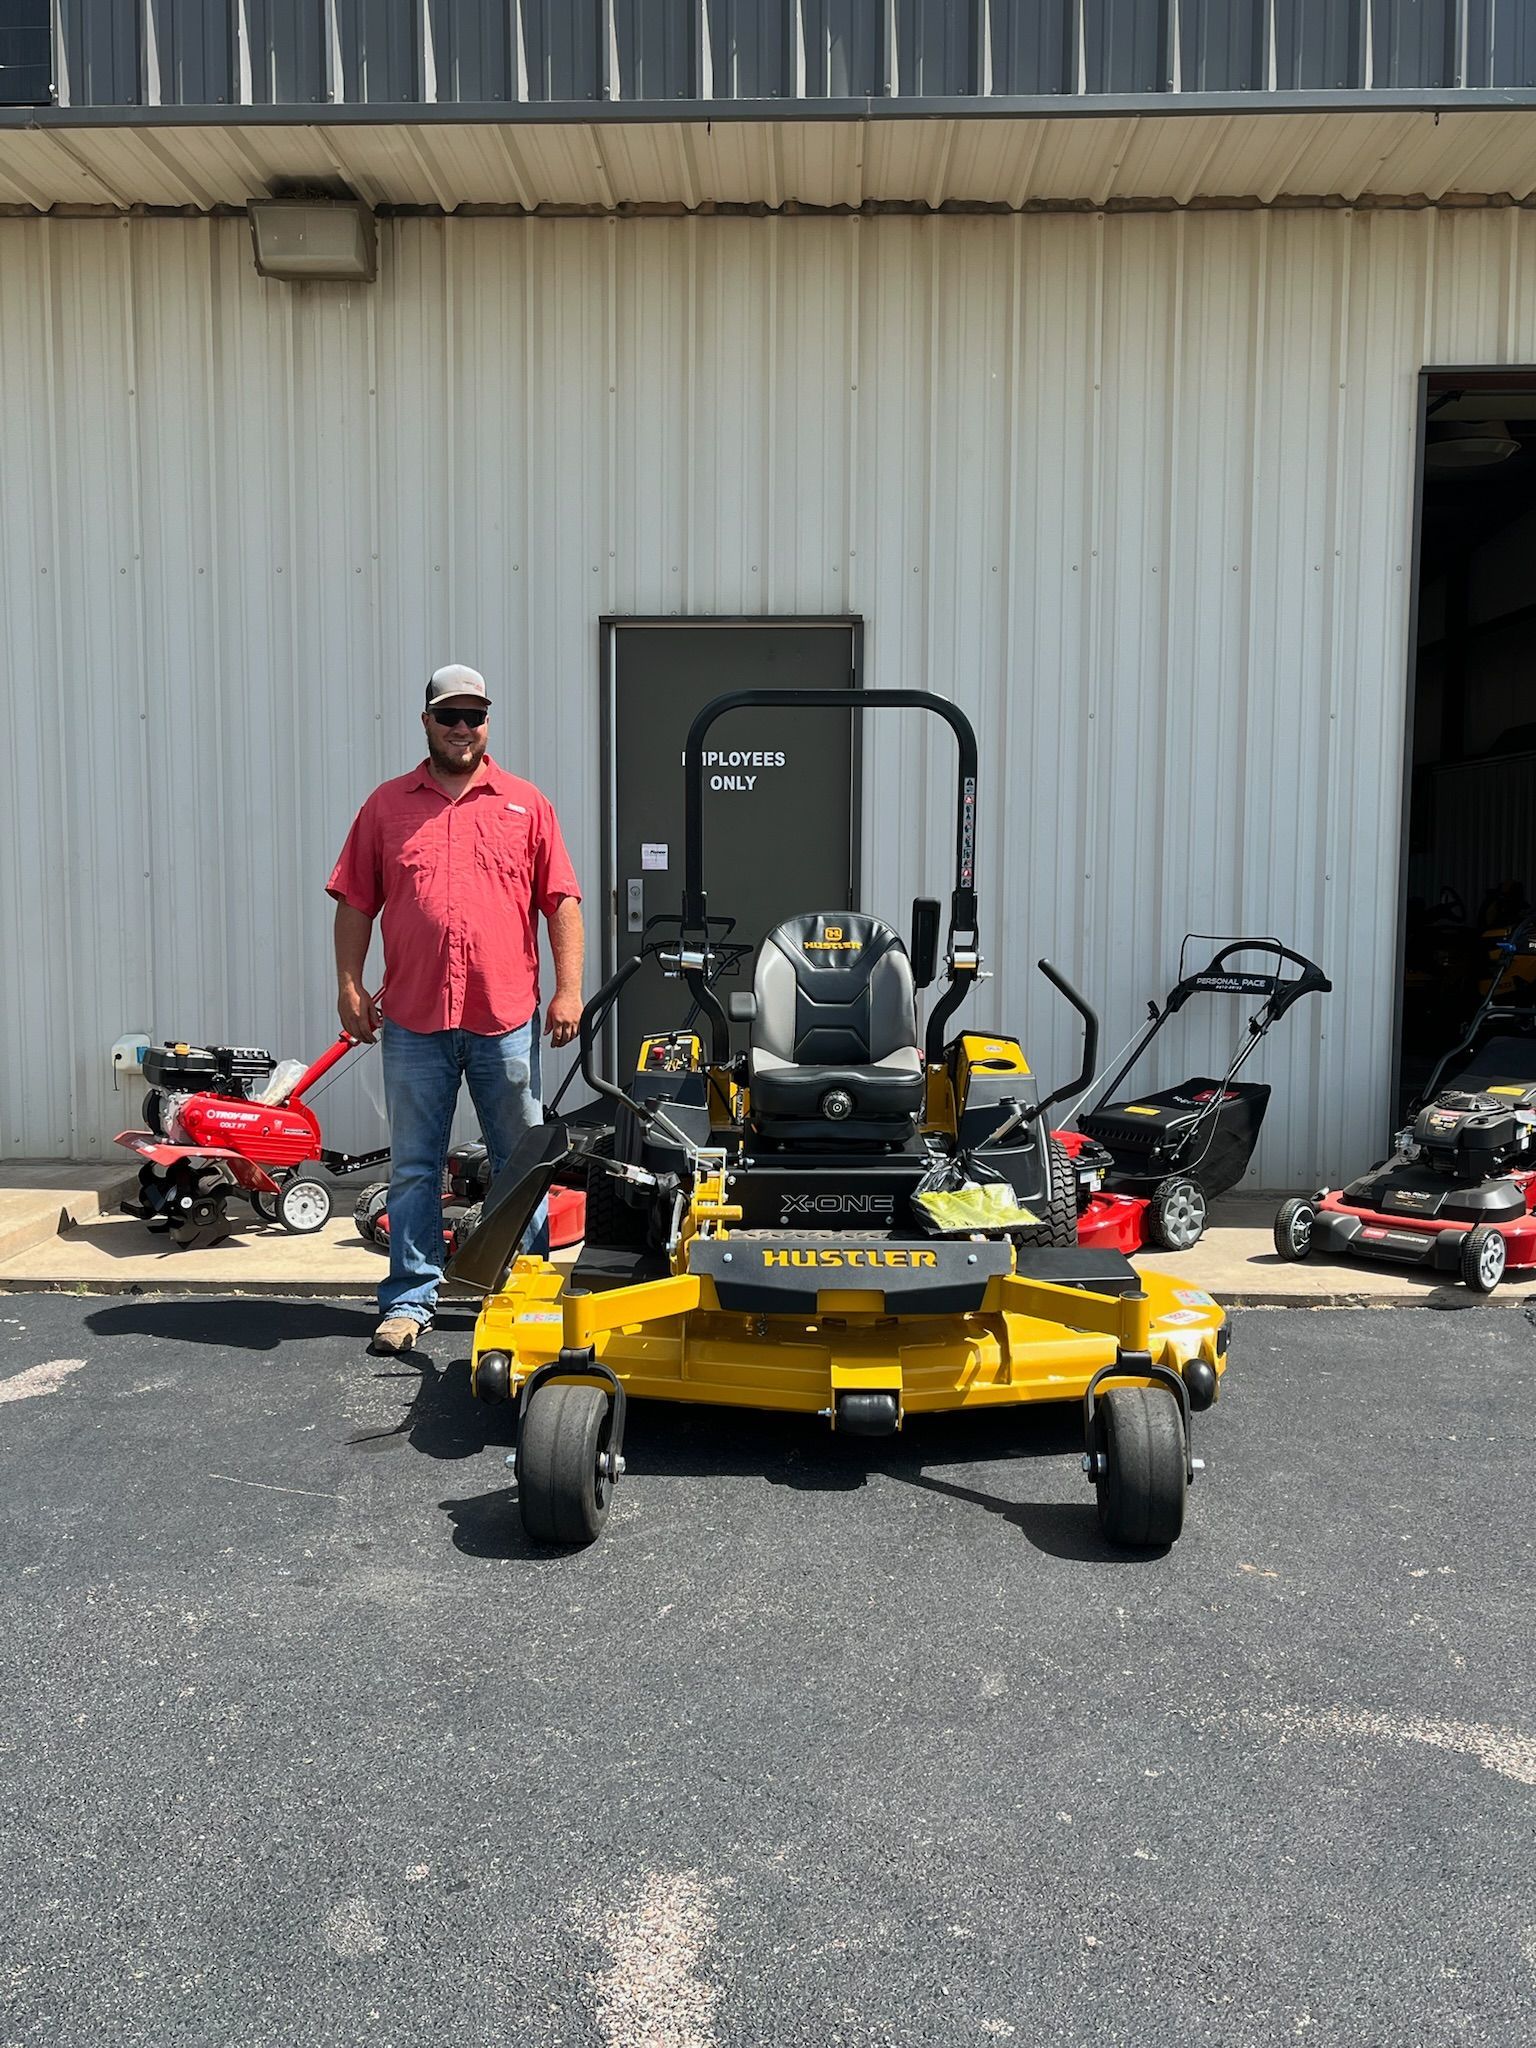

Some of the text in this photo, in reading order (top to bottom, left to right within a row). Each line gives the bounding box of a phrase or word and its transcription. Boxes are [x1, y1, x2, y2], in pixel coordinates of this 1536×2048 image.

[682, 751, 786, 766] PLOYEES
[710, 775, 757, 790] ONLY
[804, 941, 863, 950] HUSTLER
[1196, 977, 1266, 987] PERSONAL PACE
[215, 1110, 260, 1122] TROY-BILT
[780, 1194, 894, 1213] X-ONE
[762, 1249, 938, 1268] HUSTLER
